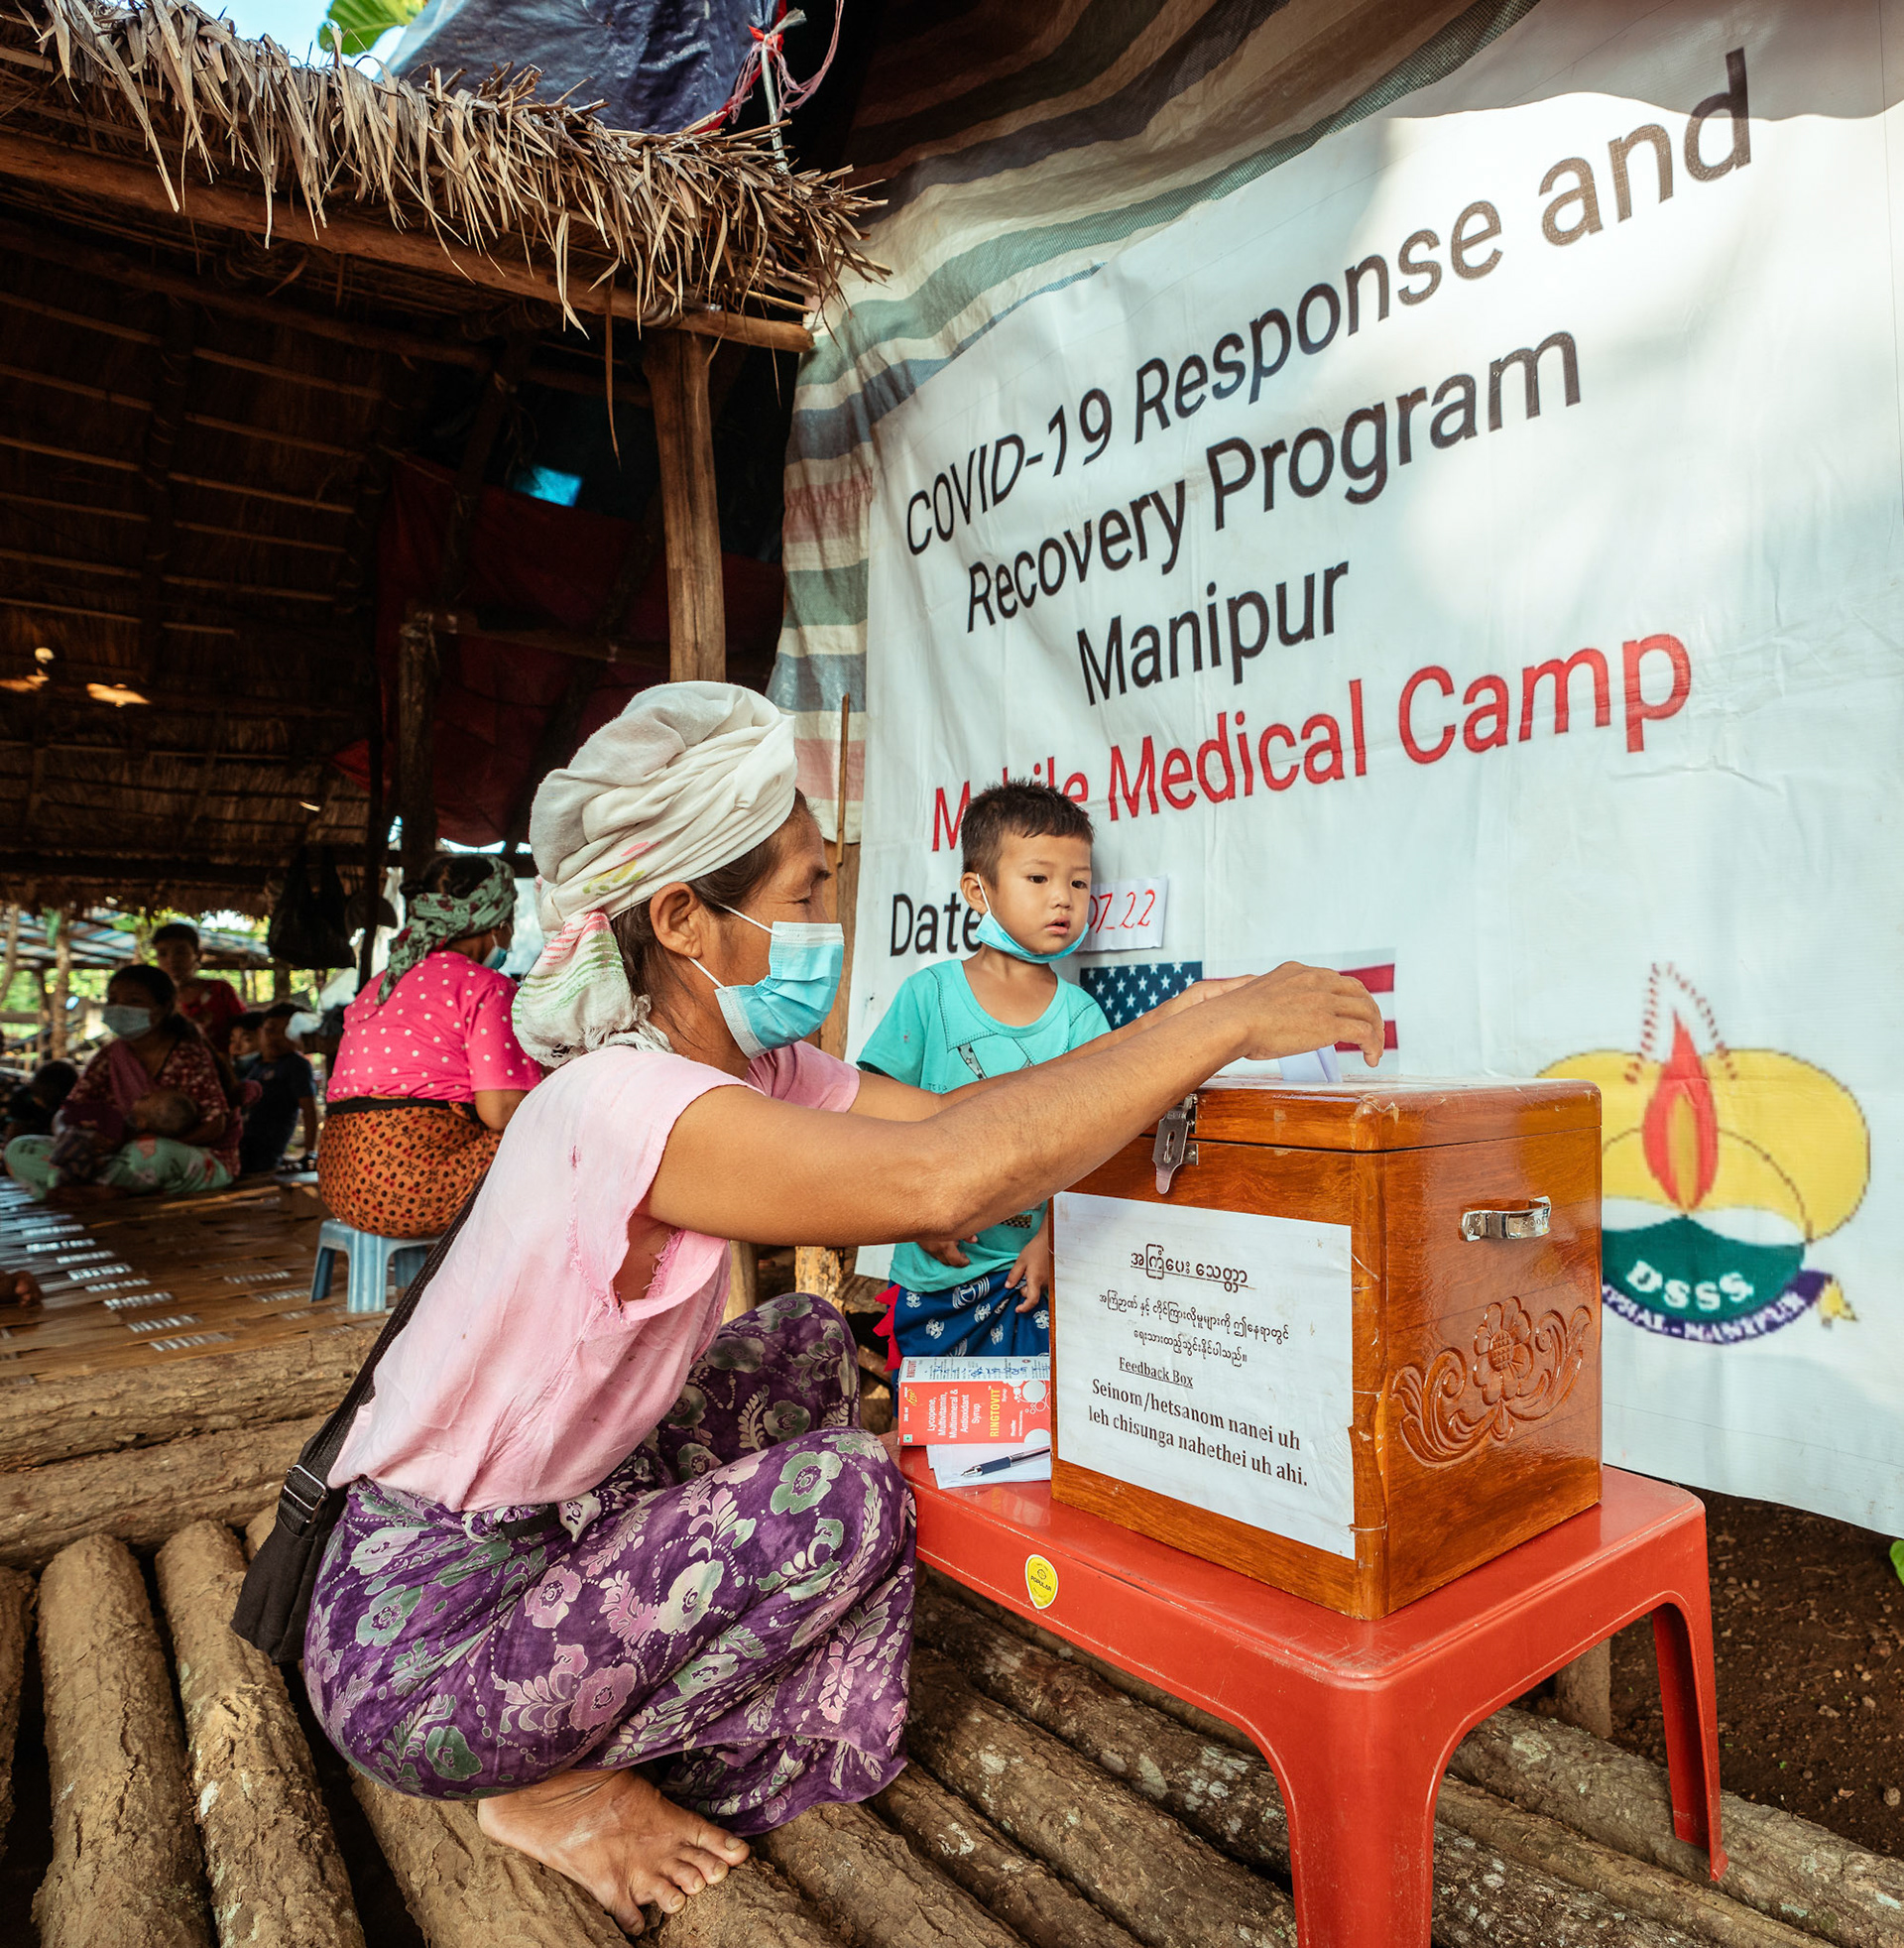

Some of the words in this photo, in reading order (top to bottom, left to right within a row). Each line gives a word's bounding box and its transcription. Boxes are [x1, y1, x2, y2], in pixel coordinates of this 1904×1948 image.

[906, 389, 1113, 555] COVID-19
[1132, 198, 1503, 444] Response
[1538, 48, 1753, 247] and
[966, 477, 1185, 633] Recovery
[1206, 330, 1582, 530] Program
[1077, 560, 1349, 706] Manipur
[1109, 679, 1368, 821] Medical
[1398, 633, 1692, 764] Camp
[1625, 1260, 1755, 1312] DSSS
[1119, 1356, 1170, 1383] Feedback
[1172, 1373, 1194, 1389] Box
[927, 1397, 937, 1431] Lycopene,
[938, 1392, 948, 1436] Multivitamin,
[949, 1399, 958, 1438] Multimineral
[960, 1395, 970, 1433] Antioxidant
[972, 1403, 982, 1424] Syrup
[990, 1389, 1001, 1437] RINGTOVIT
[1092, 1378, 1225, 1429] Seinom/hetsanom
[1229, 1418, 1274, 1444] nanei
[1277, 1430, 1301, 1451] uh
[1089, 1404, 1110, 1426] leh
[1113, 1414, 1174, 1449] chisunga
[1178, 1434, 1248, 1469] nahethei
[1250, 1456, 1272, 1477] uh
[1276, 1462, 1308, 1487] ahi.
